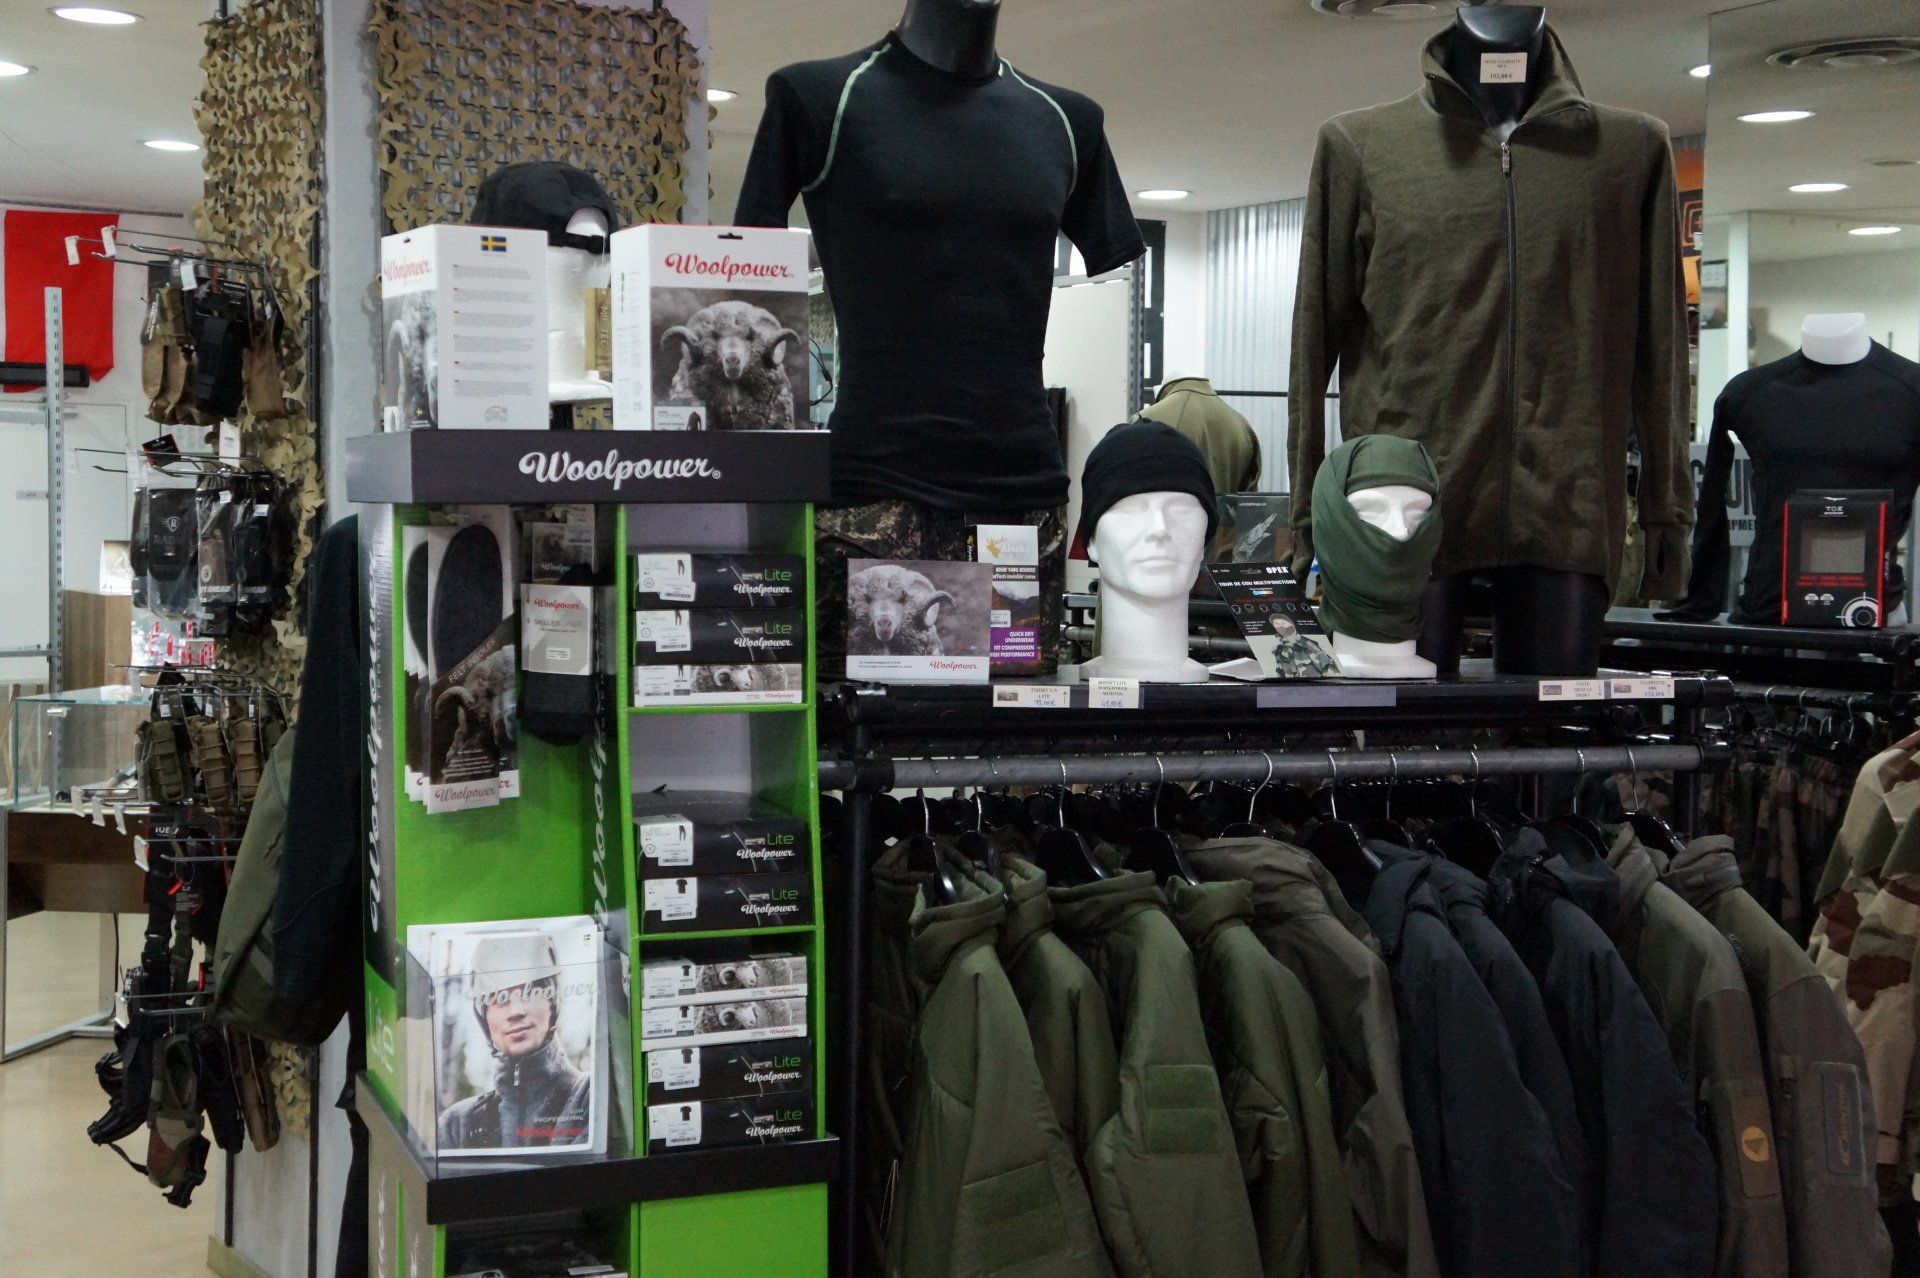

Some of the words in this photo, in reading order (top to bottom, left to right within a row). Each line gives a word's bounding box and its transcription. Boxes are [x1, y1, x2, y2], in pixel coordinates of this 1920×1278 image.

[383, 256, 431, 283] Woolpower
[664, 252, 789, 282] Woolpower
[518, 449, 714, 491] Woolpower
[764, 568, 792, 581] Lite
[1265, 566, 1288, 574] OPEX
[733, 583, 791, 597] Woolpower
[534, 598, 581, 611] Woolpower
[764, 621, 792, 635] Lite
[733, 637, 792, 650] Woolpower
[929, 660, 978, 672] Woolpower
[448, 664, 467, 684] FELT
[434, 786, 496, 803] Woolpower
[767, 833, 794, 846] Lite
[736, 848, 795, 861] Woolpower
[771, 888, 798, 900] Lite
[741, 903, 799, 916] Woolpower
[774, 1055, 801, 1068] Lite
[744, 1071, 801, 1084] Woolpower
[775, 1109, 803, 1122] Lite
[745, 1125, 803, 1138] Woolpower
